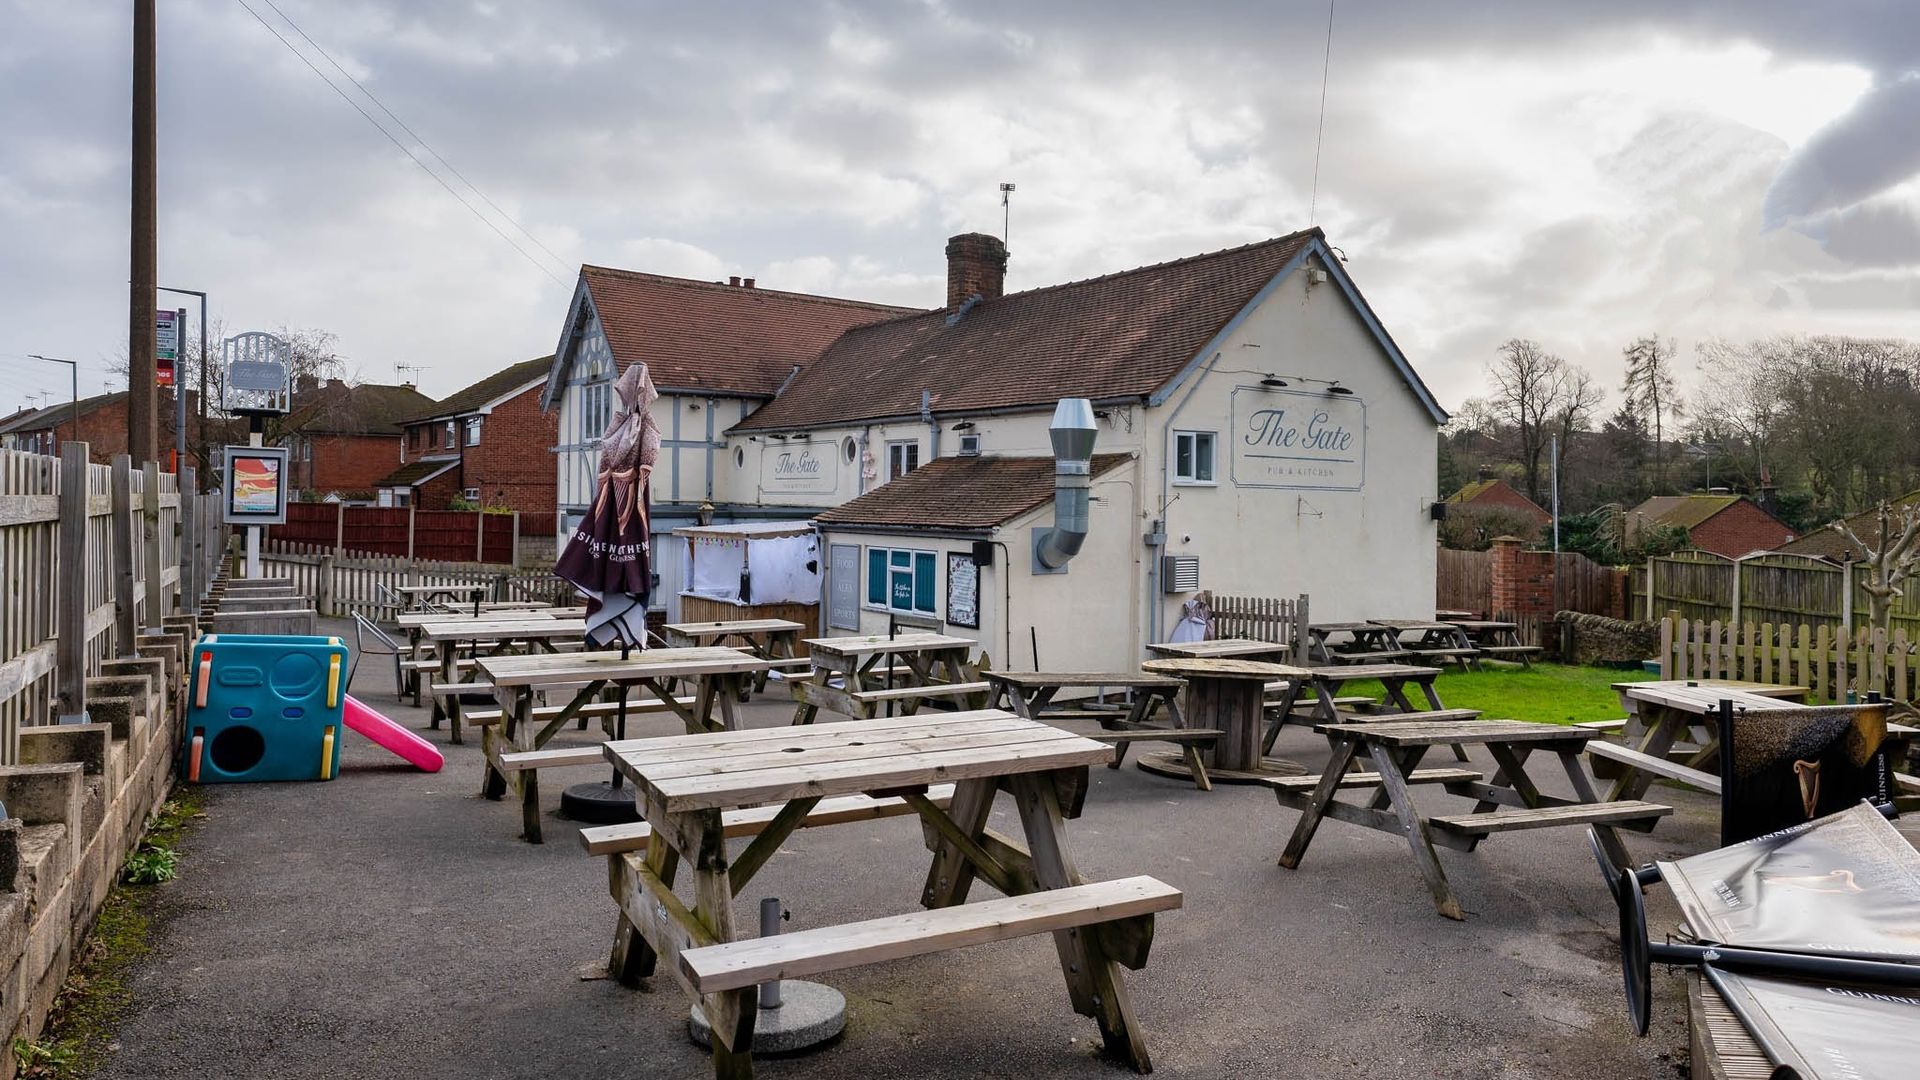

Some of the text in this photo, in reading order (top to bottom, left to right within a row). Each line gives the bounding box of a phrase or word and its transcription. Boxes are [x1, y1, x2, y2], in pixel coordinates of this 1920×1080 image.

[1245, 410, 1354, 450] The Gate
[775, 450, 820, 473] The Gate
[837, 559, 854, 569] FOOD
